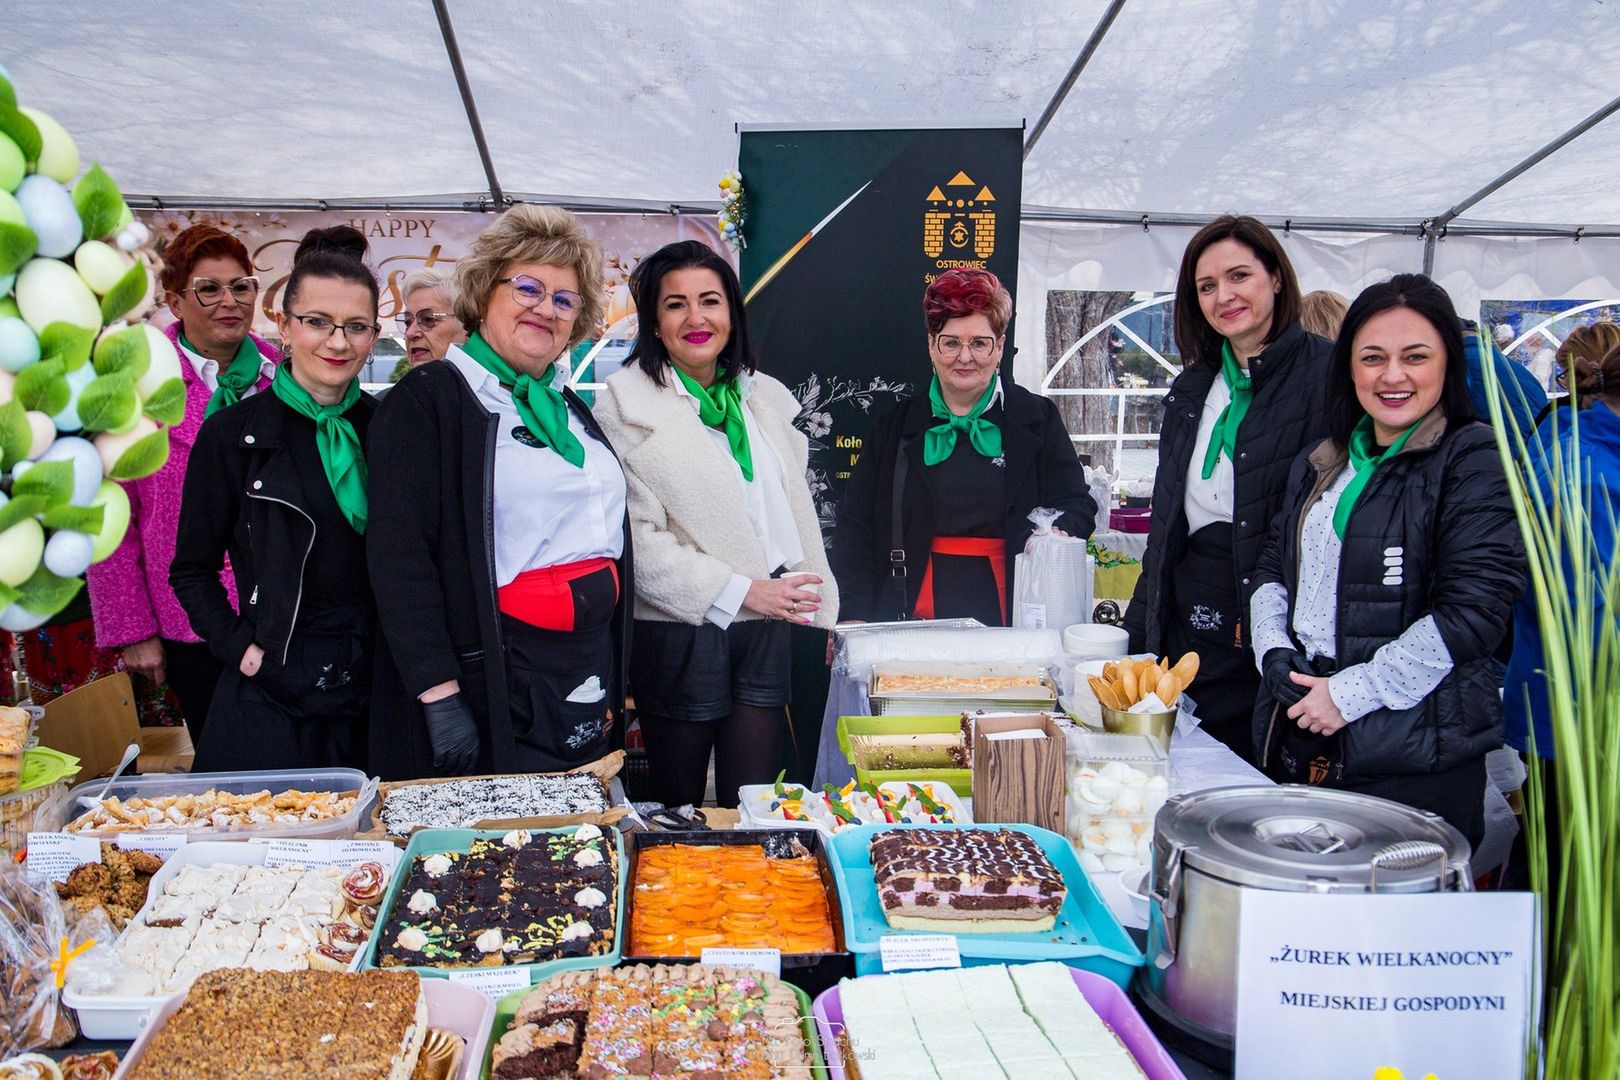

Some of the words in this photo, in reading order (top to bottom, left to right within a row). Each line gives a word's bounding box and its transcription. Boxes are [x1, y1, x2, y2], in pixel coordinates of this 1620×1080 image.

[349, 218, 436, 238] HAPPY
[936, 260, 987, 269] OSTROWIEC
[835, 435, 862, 449] Koło
[1270, 944, 1351, 966] „ŻUREK
[1358, 950, 1513, 967] WIELKANOCNY”
[1280, 991, 1388, 1011] MIEJSKIEJ
[1394, 995, 1506, 1011] GOSPODYNI
